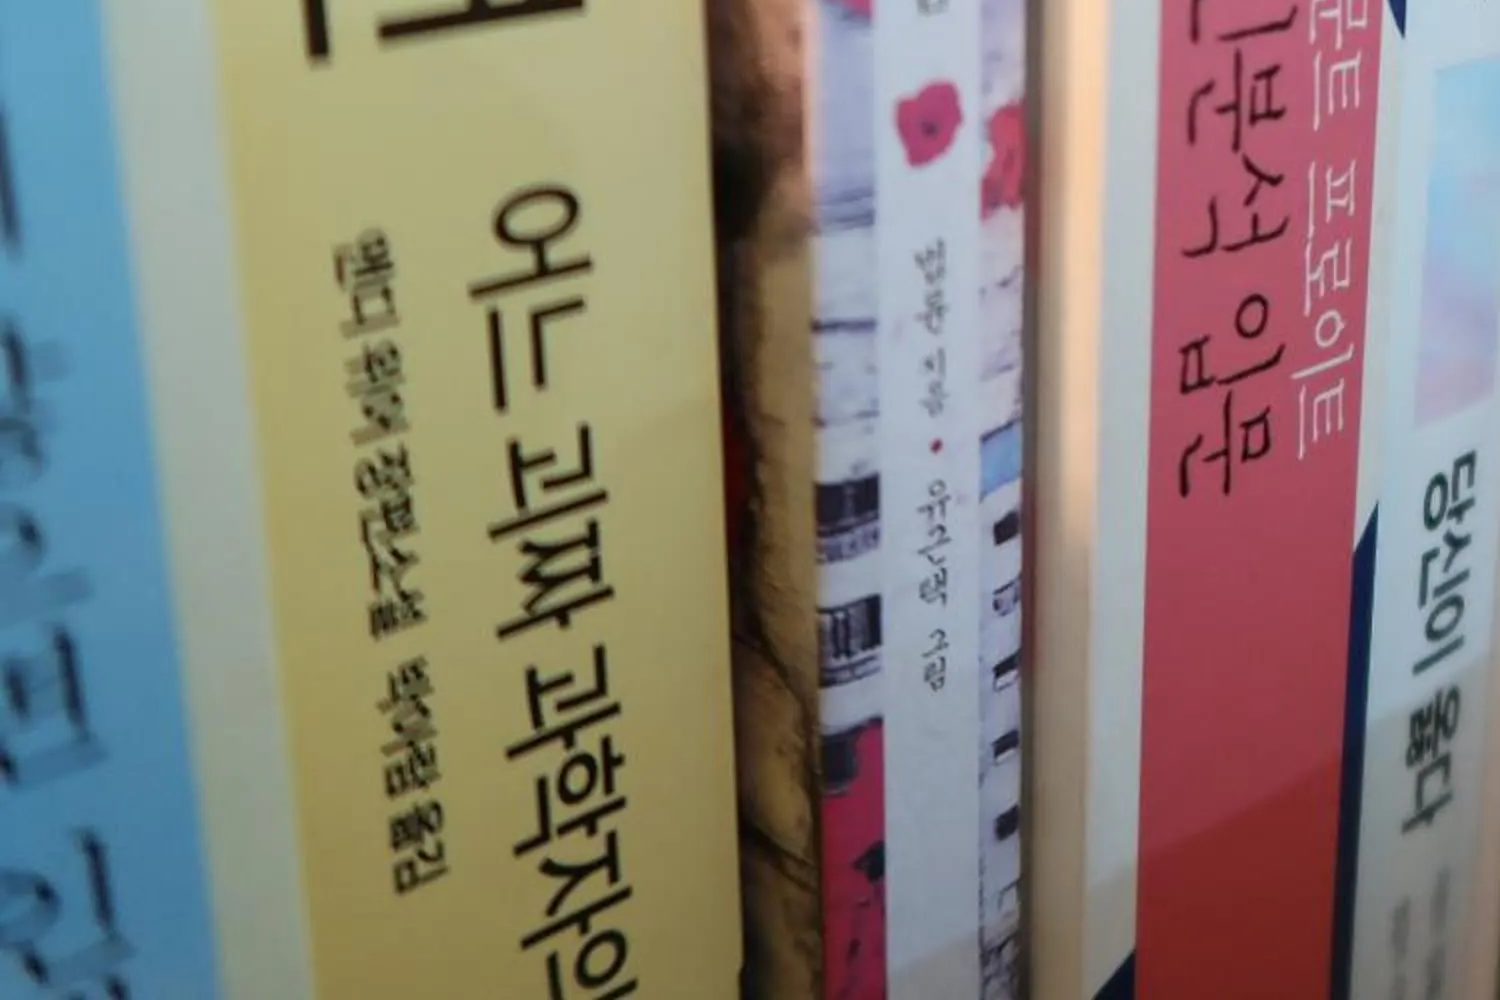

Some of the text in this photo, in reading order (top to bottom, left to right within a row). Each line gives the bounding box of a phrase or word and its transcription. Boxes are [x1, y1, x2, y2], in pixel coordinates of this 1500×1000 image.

[469, 183, 593, 411] 어느
[1179, 293, 1286, 498] 입문
[1291, 160, 1356, 460] 프로이트
[488, 424, 614, 640] 괴짜
[1402, 450, 1476, 834] 당신이 옳다
